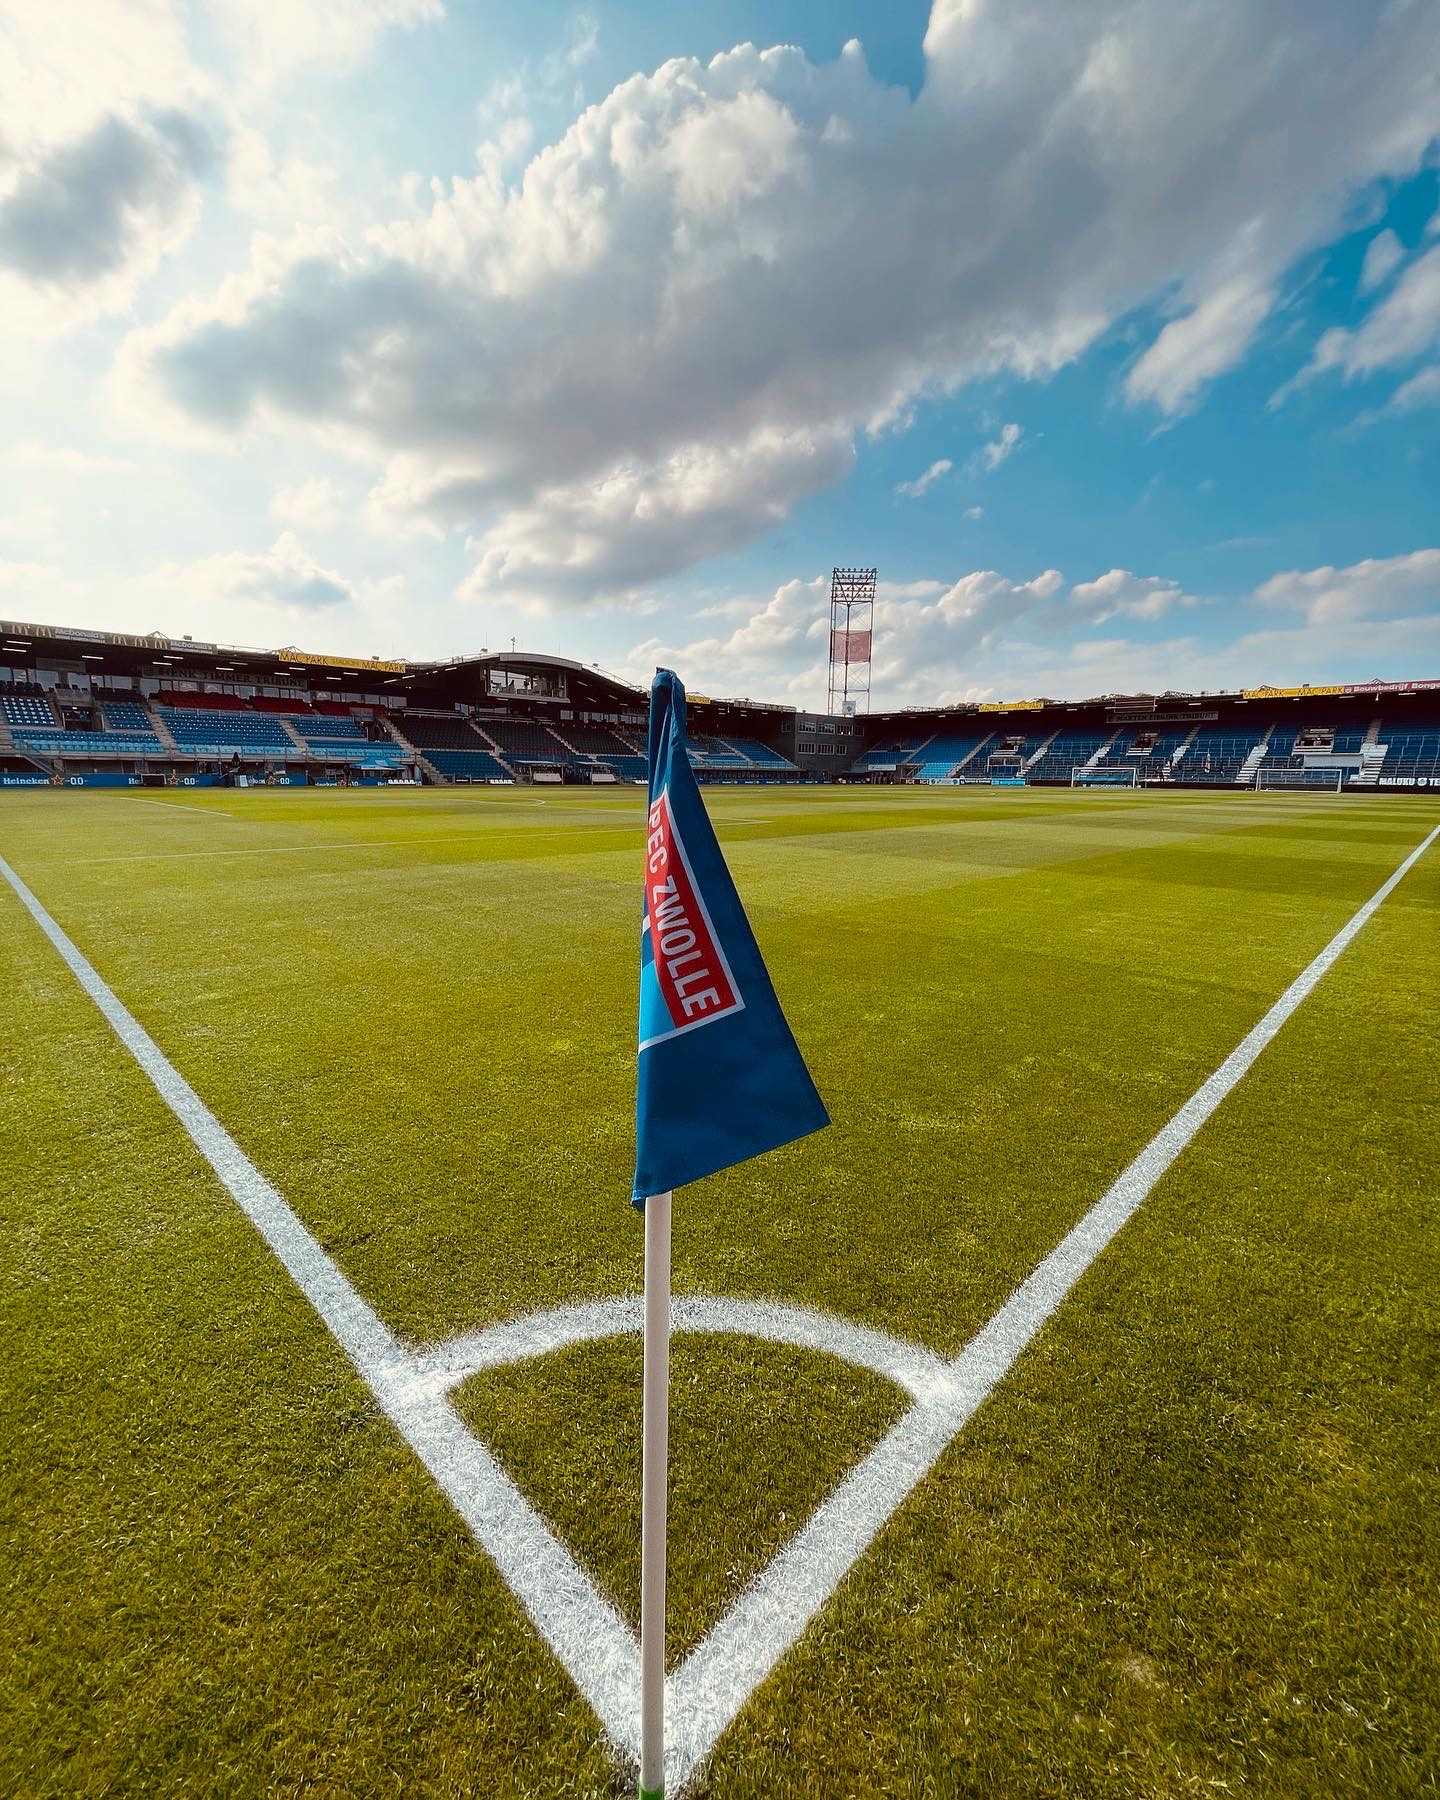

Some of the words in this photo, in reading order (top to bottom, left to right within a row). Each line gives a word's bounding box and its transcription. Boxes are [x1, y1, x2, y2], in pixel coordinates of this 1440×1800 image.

[1353, 683, 1408, 693] Bouwbedrijf
[3, 777, 50, 785] Heineken
[652, 875, 721, 1017] ZWOLLE
